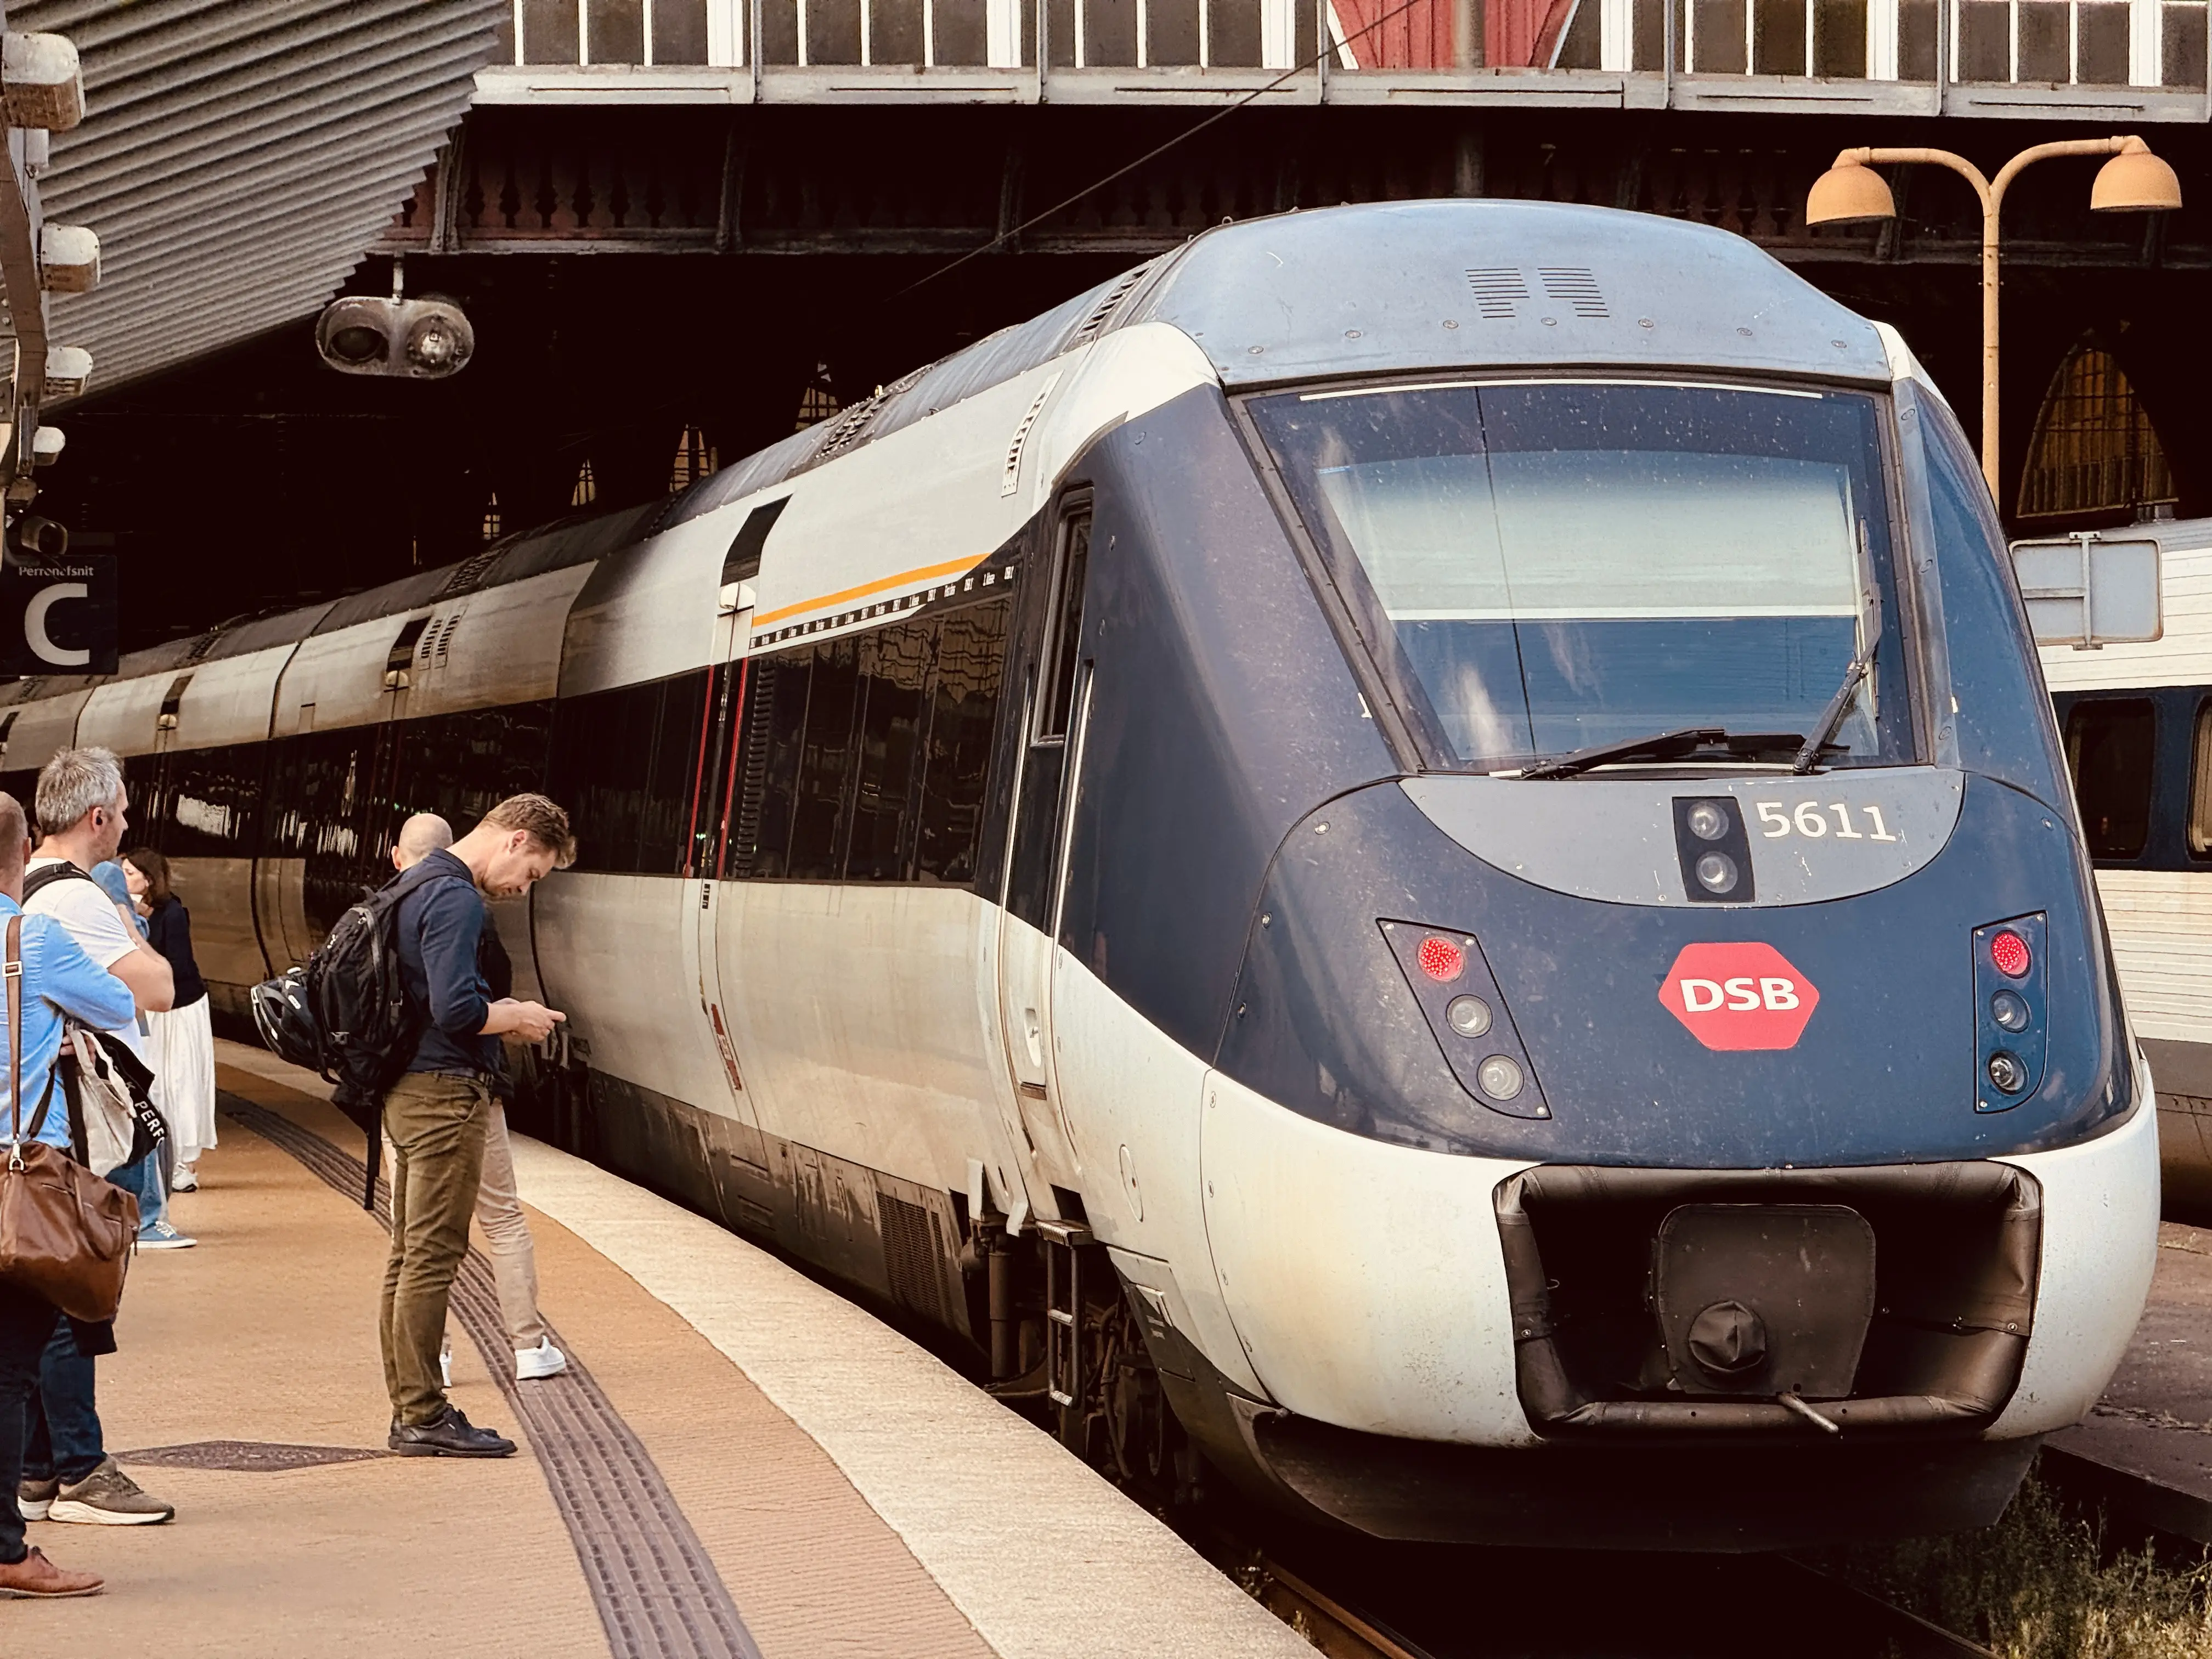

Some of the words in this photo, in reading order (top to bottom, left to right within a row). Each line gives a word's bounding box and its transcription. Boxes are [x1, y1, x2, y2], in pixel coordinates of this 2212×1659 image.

[25, 583, 89, 665] C
[1757, 802, 1896, 841] 5611
[1680, 978, 1799, 1012] DSB
